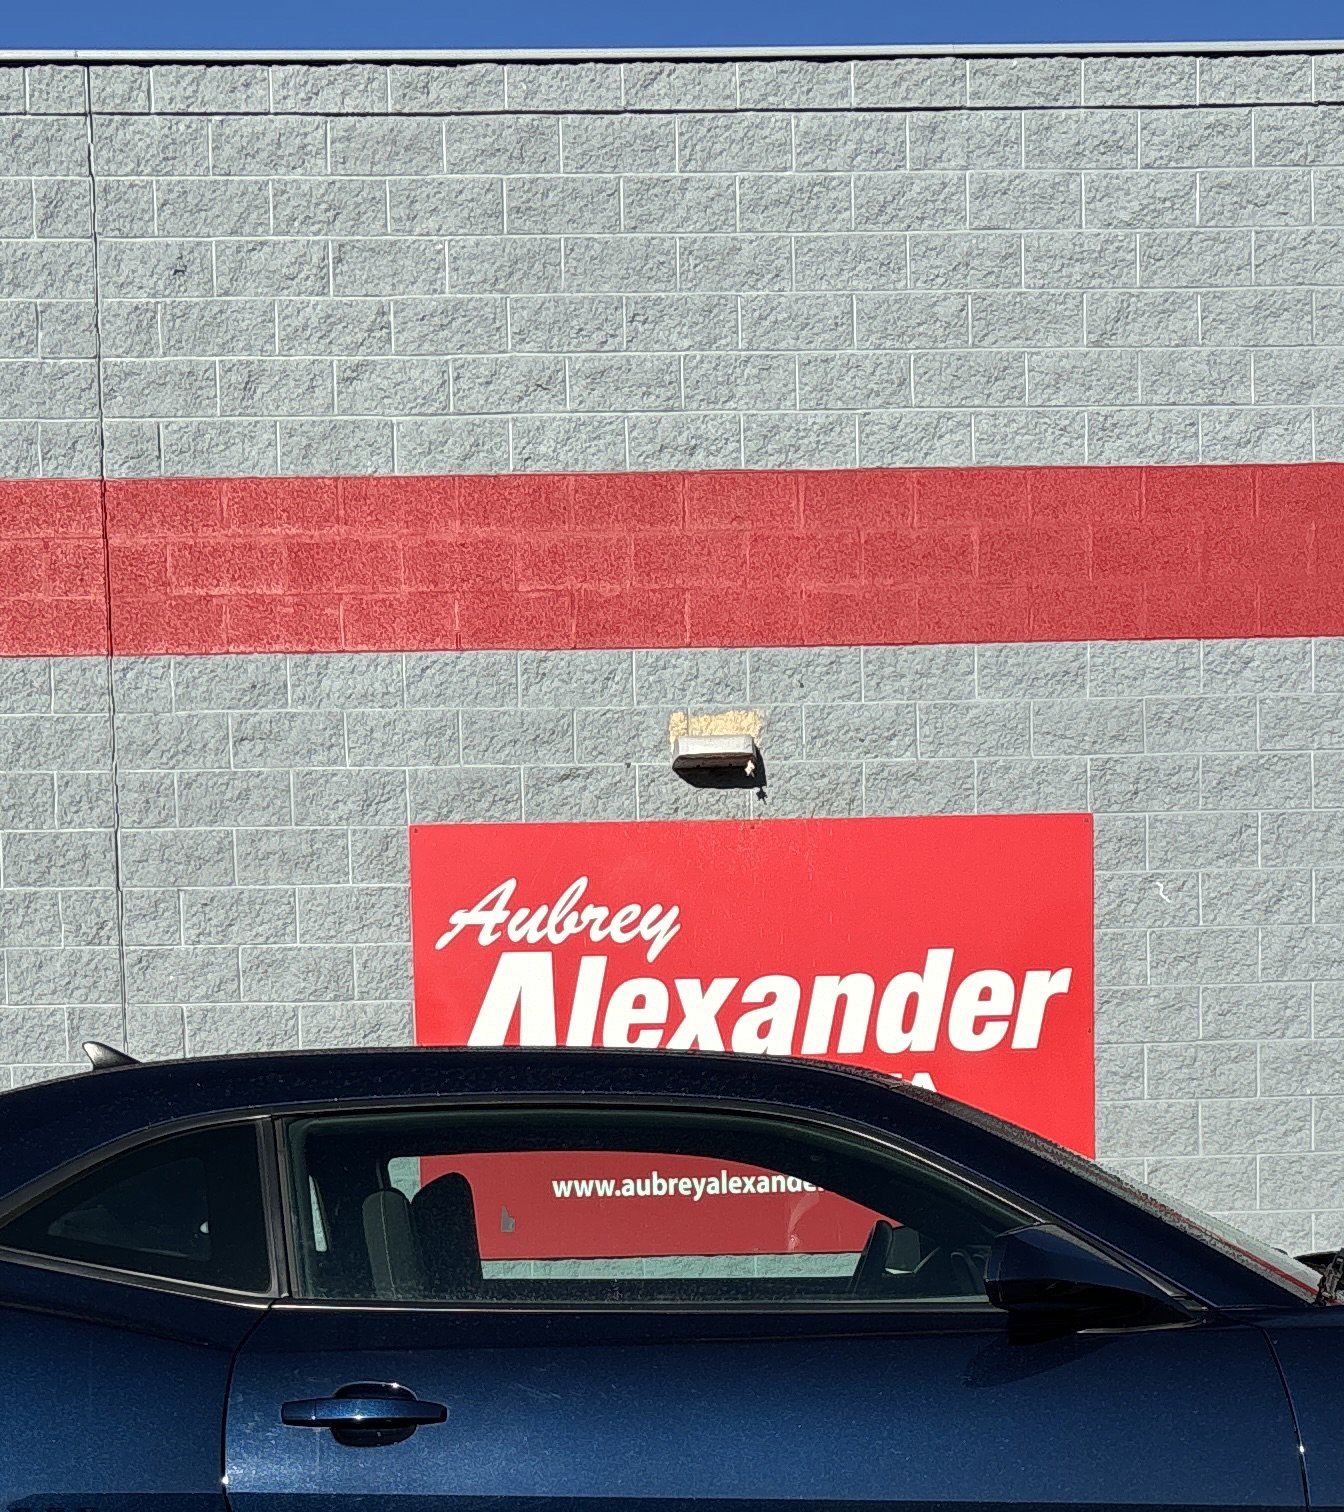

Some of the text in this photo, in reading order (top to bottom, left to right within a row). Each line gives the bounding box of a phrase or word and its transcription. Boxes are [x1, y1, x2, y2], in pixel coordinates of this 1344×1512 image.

[434, 875, 682, 964] Aubrey
[467, 948, 1073, 1055] Alexander
[551, 1169, 825, 1202] www.aubreyalexande
